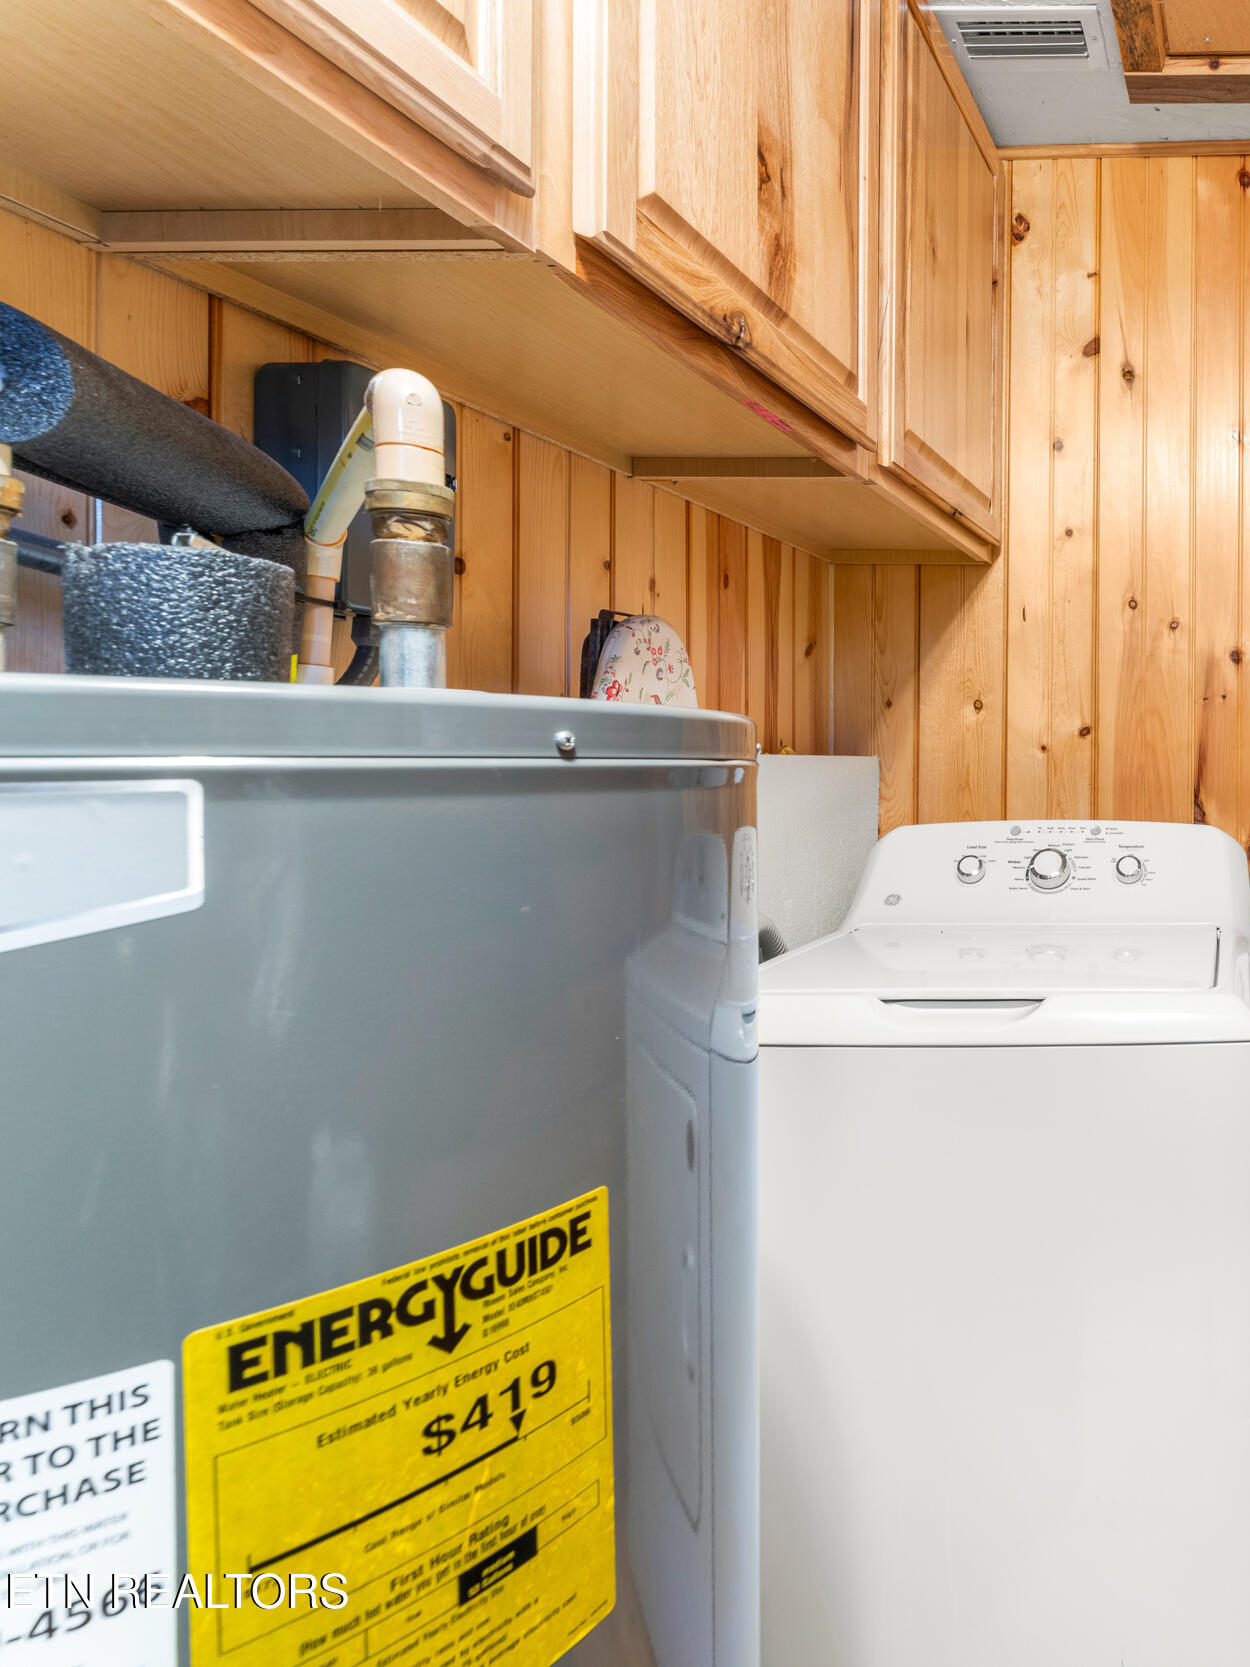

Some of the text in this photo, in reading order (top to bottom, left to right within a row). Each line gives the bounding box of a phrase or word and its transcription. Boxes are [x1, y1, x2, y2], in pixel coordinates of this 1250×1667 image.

[228, 1210, 592, 1393] ENERGYGUIDE
[61, 1383, 149, 1425] THIS
[316, 1342, 530, 1449] Estimated Yearly Energy Cost
[421, 1359, 557, 1457] $419
[23, 1445, 75, 1476] TO
[86, 1417, 161, 1458] THE
[390, 1514, 510, 1592] First Hour Rating
